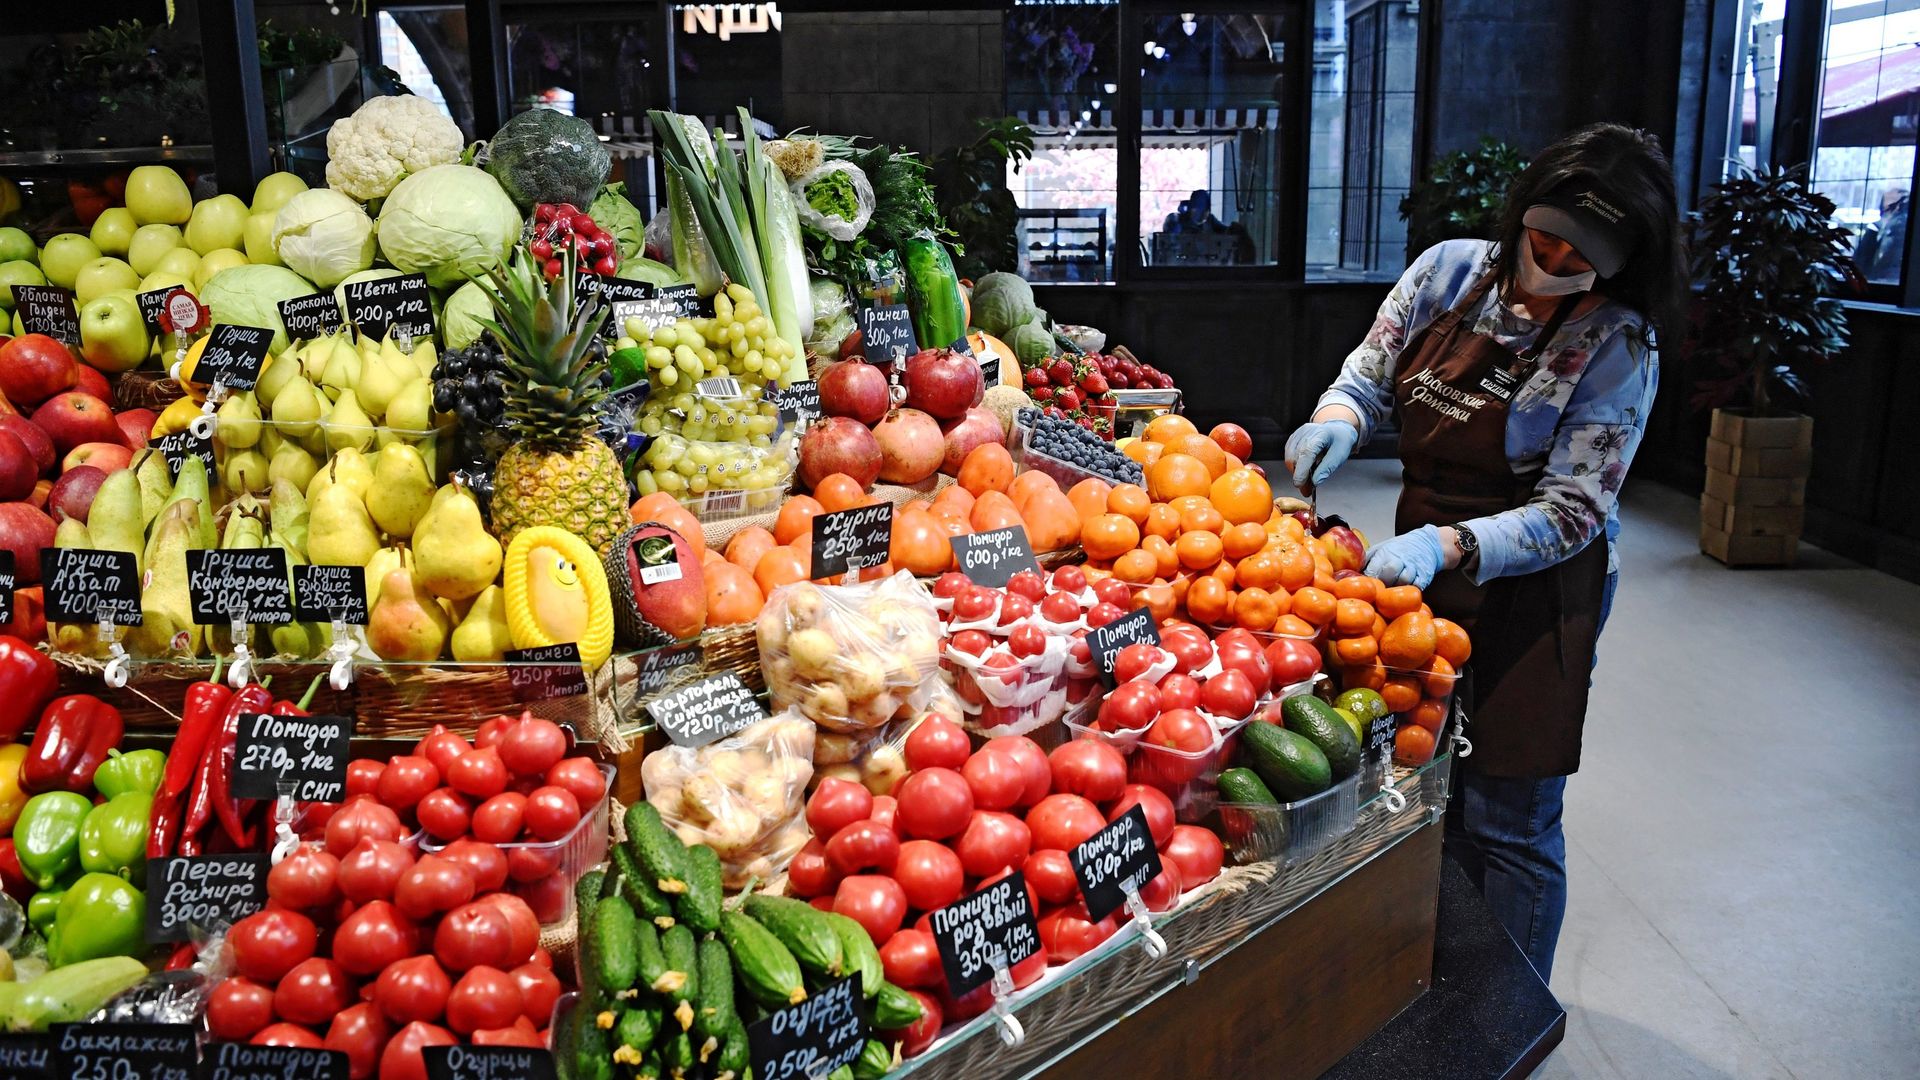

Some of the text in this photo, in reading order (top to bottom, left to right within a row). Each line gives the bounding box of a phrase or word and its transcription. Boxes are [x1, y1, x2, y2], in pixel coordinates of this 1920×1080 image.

[19, 286, 64, 303] Яблоки
[283, 294, 335, 319] Брокколи
[29, 303, 66, 323] Голден
[287, 308, 339, 333] 400р 1кг
[354, 299, 428, 327] 200р 1кг
[864, 307, 910, 330] Гранат
[217, 325, 259, 345] Груша
[866, 326, 910, 350] 300р 1кг
[200, 346, 257, 373] 280р 1кг
[1402, 367, 1487, 410] Московские
[1404, 386, 1473, 423] Ярмарки
[823, 505, 892, 539] Хурма
[822, 528, 890, 559] 250р 1кг
[967, 530, 1013, 550] Помидор
[57, 548, 121, 578] Груша
[201, 550, 274, 577] Груша
[860, 551, 888, 569] СНГ
[965, 545, 1024, 570] 600р 1кг
[50, 568, 121, 592] Аббат
[190, 570, 289, 597] Конференц
[298, 578, 352, 593] Дюшес
[307, 565, 351, 583] Груша
[252, 593, 287, 609] 1кг
[337, 593, 364, 609] 1кг
[1097, 614, 1148, 649] Помидор
[521, 645, 573, 661] Манго
[643, 651, 696, 671] Манго
[512, 666, 553, 687] 250р
[650, 674, 742, 717] Картофель
[251, 713, 340, 751] Помидор
[678, 700, 761, 738] 120р 1кг
[240, 744, 335, 779] 270р 1кг
[301, 780, 341, 801] СНГ
[1077, 816, 1133, 866] Помидор
[166, 857, 256, 887] Перец
[1084, 836, 1146, 889] 380р 1кг
[163, 881, 255, 905] Рамиро
[160, 902, 221, 928] 300р
[934, 881, 1012, 935] Помидор
[953, 890, 1027, 955] розовый
[1003, 922, 1033, 949] 1кг
[1010, 936, 1035, 964] СНГ
[60, 1024, 190, 1051] Баклажан
[827, 1016, 859, 1049] 1кг
[219, 1042, 332, 1080] Помидор
[446, 1045, 532, 1080] Огурцы
